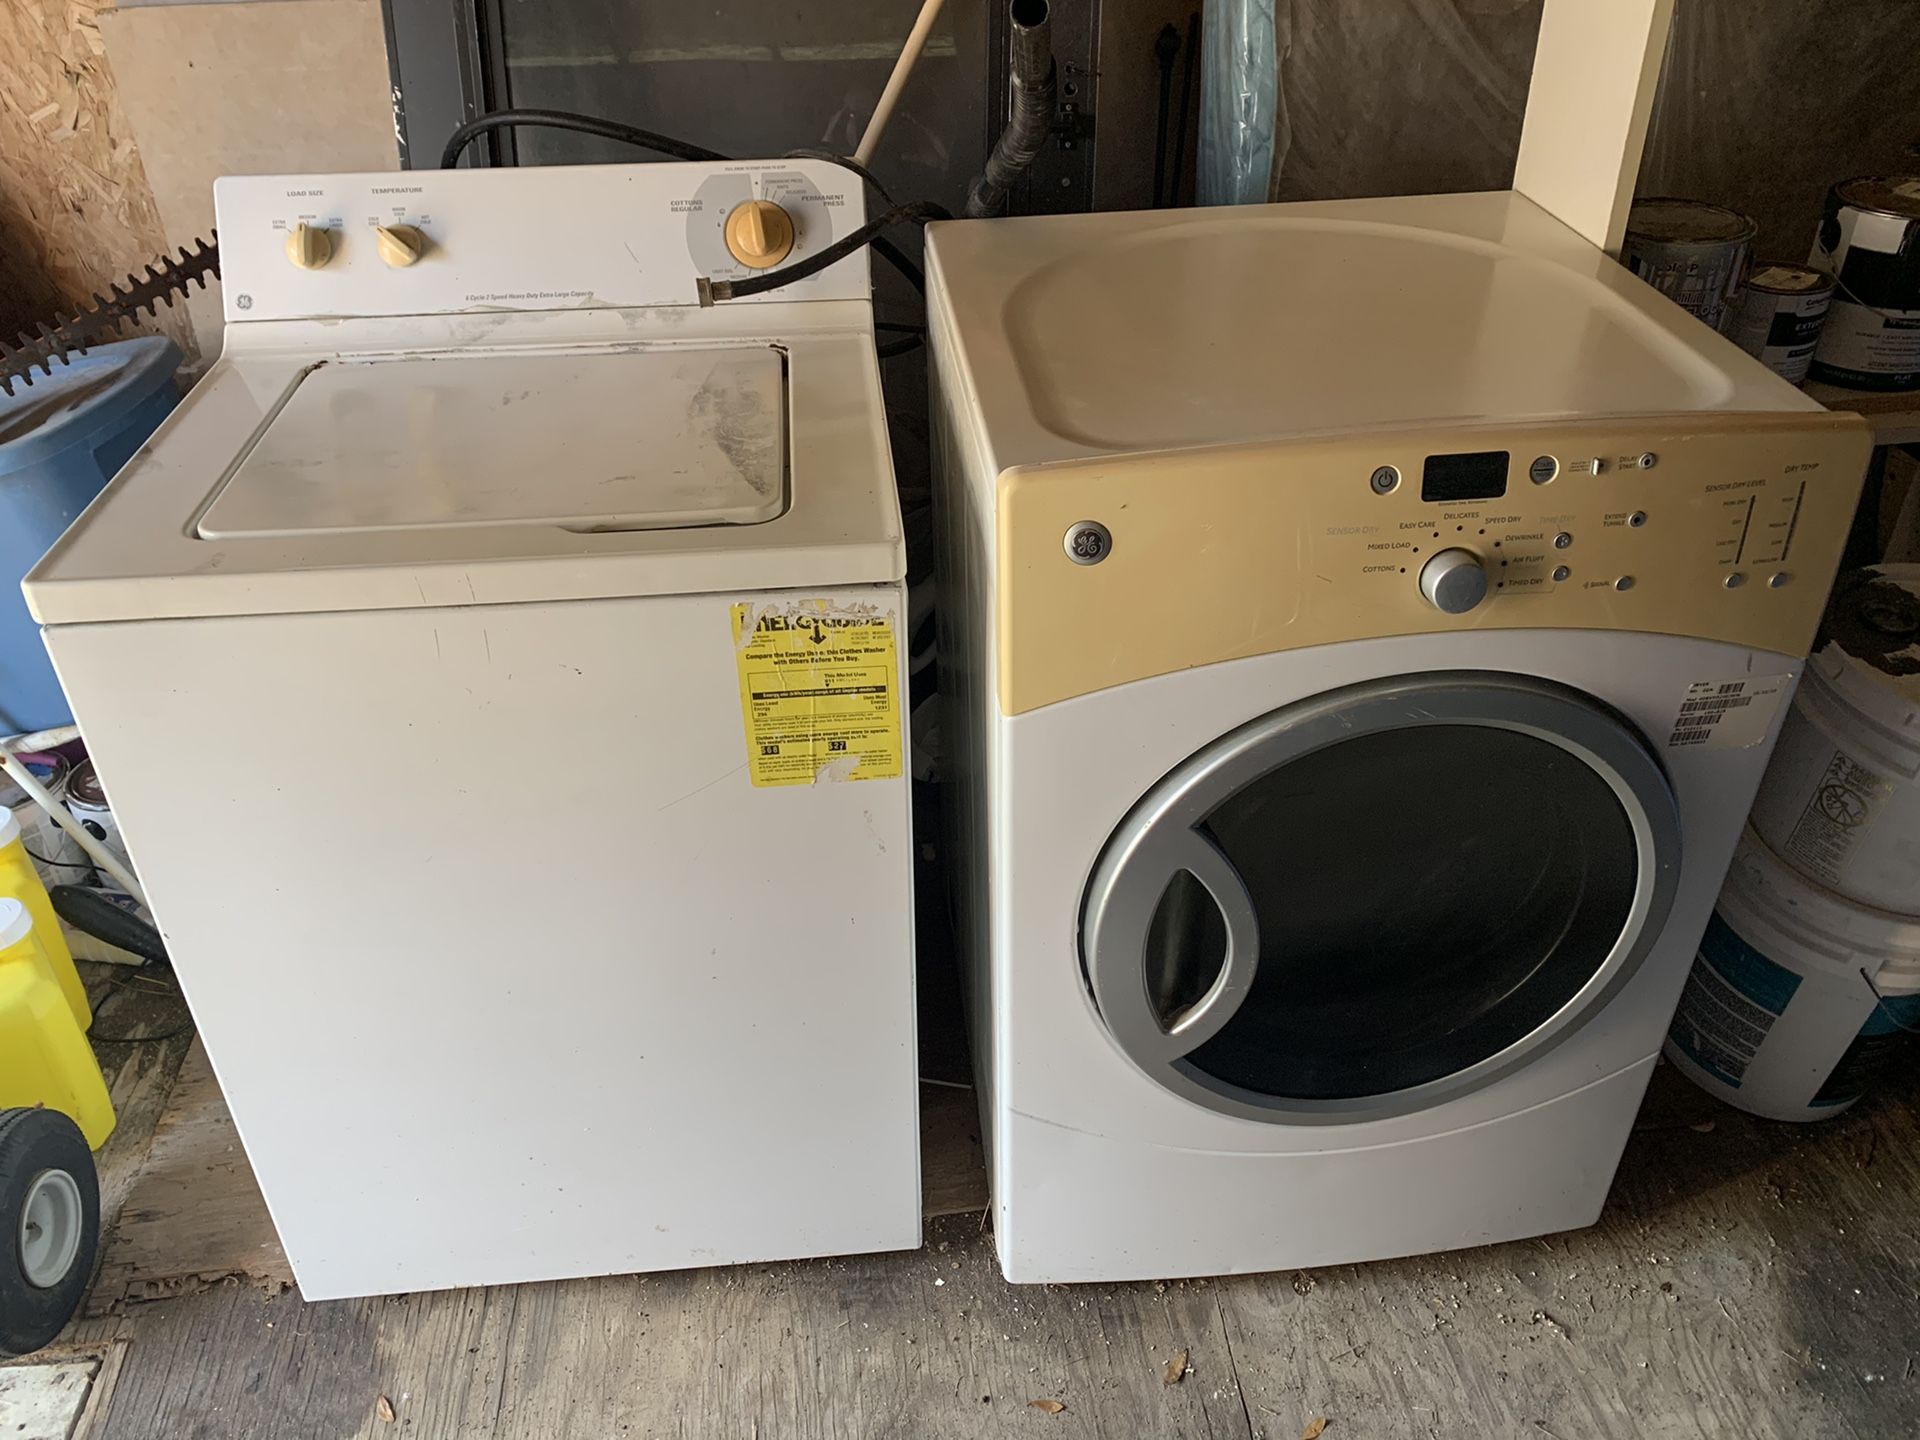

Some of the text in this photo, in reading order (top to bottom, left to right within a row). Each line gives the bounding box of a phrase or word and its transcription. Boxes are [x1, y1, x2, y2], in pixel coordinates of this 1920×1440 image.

[287, 189, 324, 198] LOAD SIZE
[371, 187, 424, 195] TEMPERATURE
[470, 294, 485, 302] Cycle
[491, 293, 508, 301] Speed
[508, 293, 525, 301] Heavy
[526, 292, 539, 300] Duty
[539, 291, 554, 299] Extra
[554, 291, 569, 299] Large
[570, 290, 595, 298] Capacity
[1784, 463, 1820, 474] DRY TEMP
[1705, 480, 1766, 492] SENSOR DRY LEVEL
[1443, 511, 1480, 520] DELICATES
[1485, 516, 1506, 524] SPEED
[1399, 521, 1436, 530] EASY CARE
[1326, 526, 1380, 536] SENSOR DRY
[1505, 533, 1544, 542] DEWRINKLE
[1367, 542, 1411, 551] MIXED LOAD
[1525, 555, 1545, 563] FLUFF
[1362, 565, 1396, 573] COTTONS
